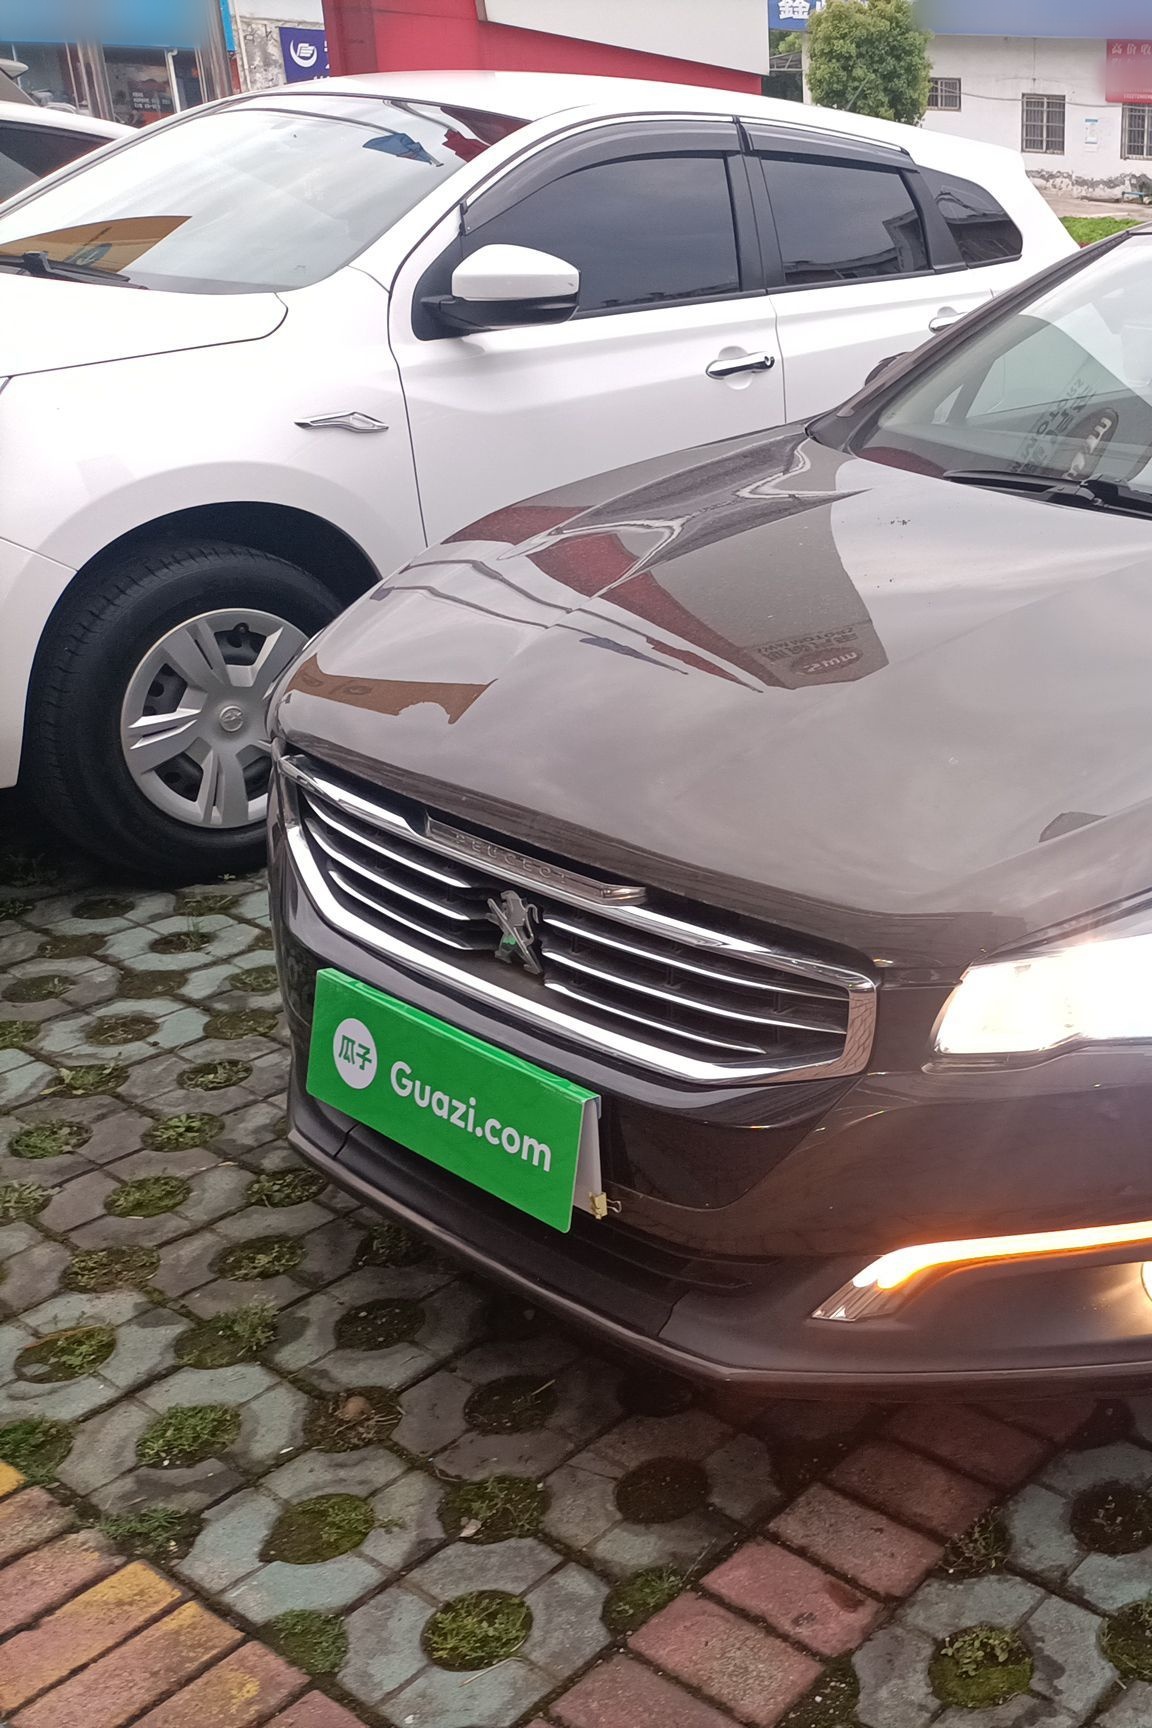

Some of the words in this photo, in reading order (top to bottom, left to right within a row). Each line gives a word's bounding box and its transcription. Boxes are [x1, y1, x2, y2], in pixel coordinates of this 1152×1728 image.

[454, 833, 568, 885] PEUGEOT
[338, 1034, 373, 1071] 瓜子
[390, 1060, 552, 1173] Guazi.com
